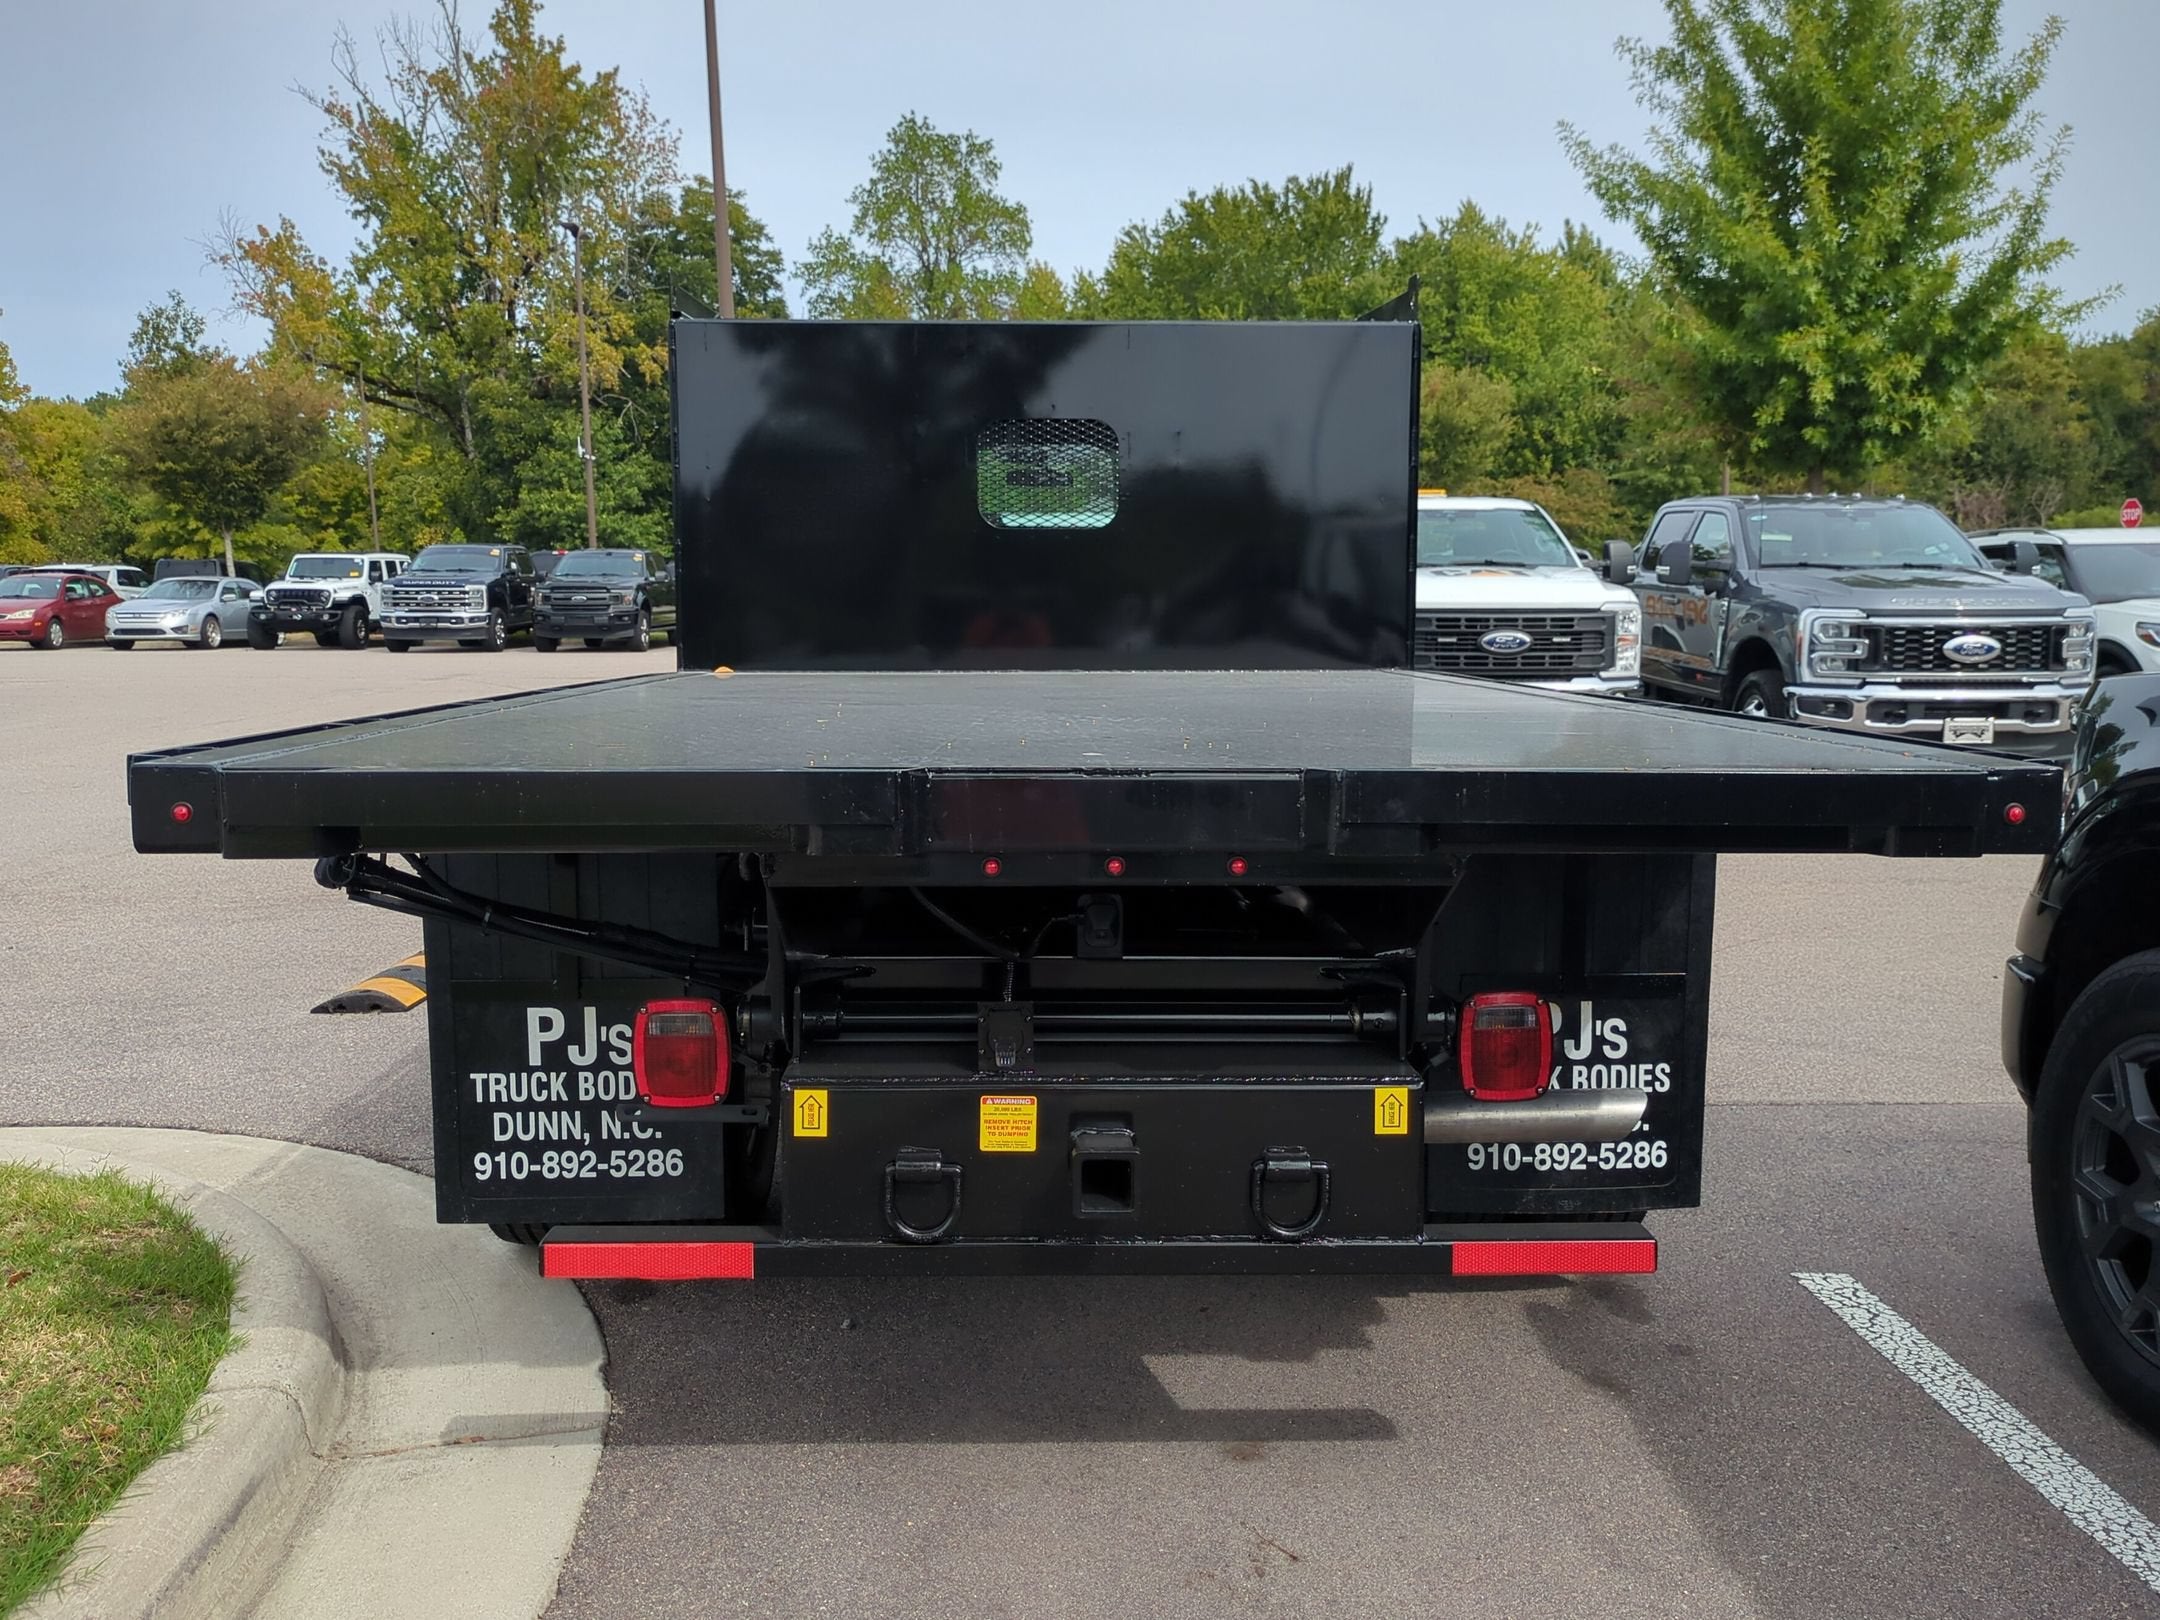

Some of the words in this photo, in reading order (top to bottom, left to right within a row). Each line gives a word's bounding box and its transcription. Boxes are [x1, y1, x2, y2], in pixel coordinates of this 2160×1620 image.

[2123, 508, 2140, 521] STOP
[1960, 642, 1988, 656] Ford
[470, 1072, 568, 1103] TRUCK
[579, 1071, 637, 1101] BOD
[1573, 1063, 1671, 1093] BODIES
[493, 1112, 590, 1146] DUNN,
[474, 1149, 683, 1180] 910-892-5286
[1467, 1141, 1668, 1171] 910-892-5286
